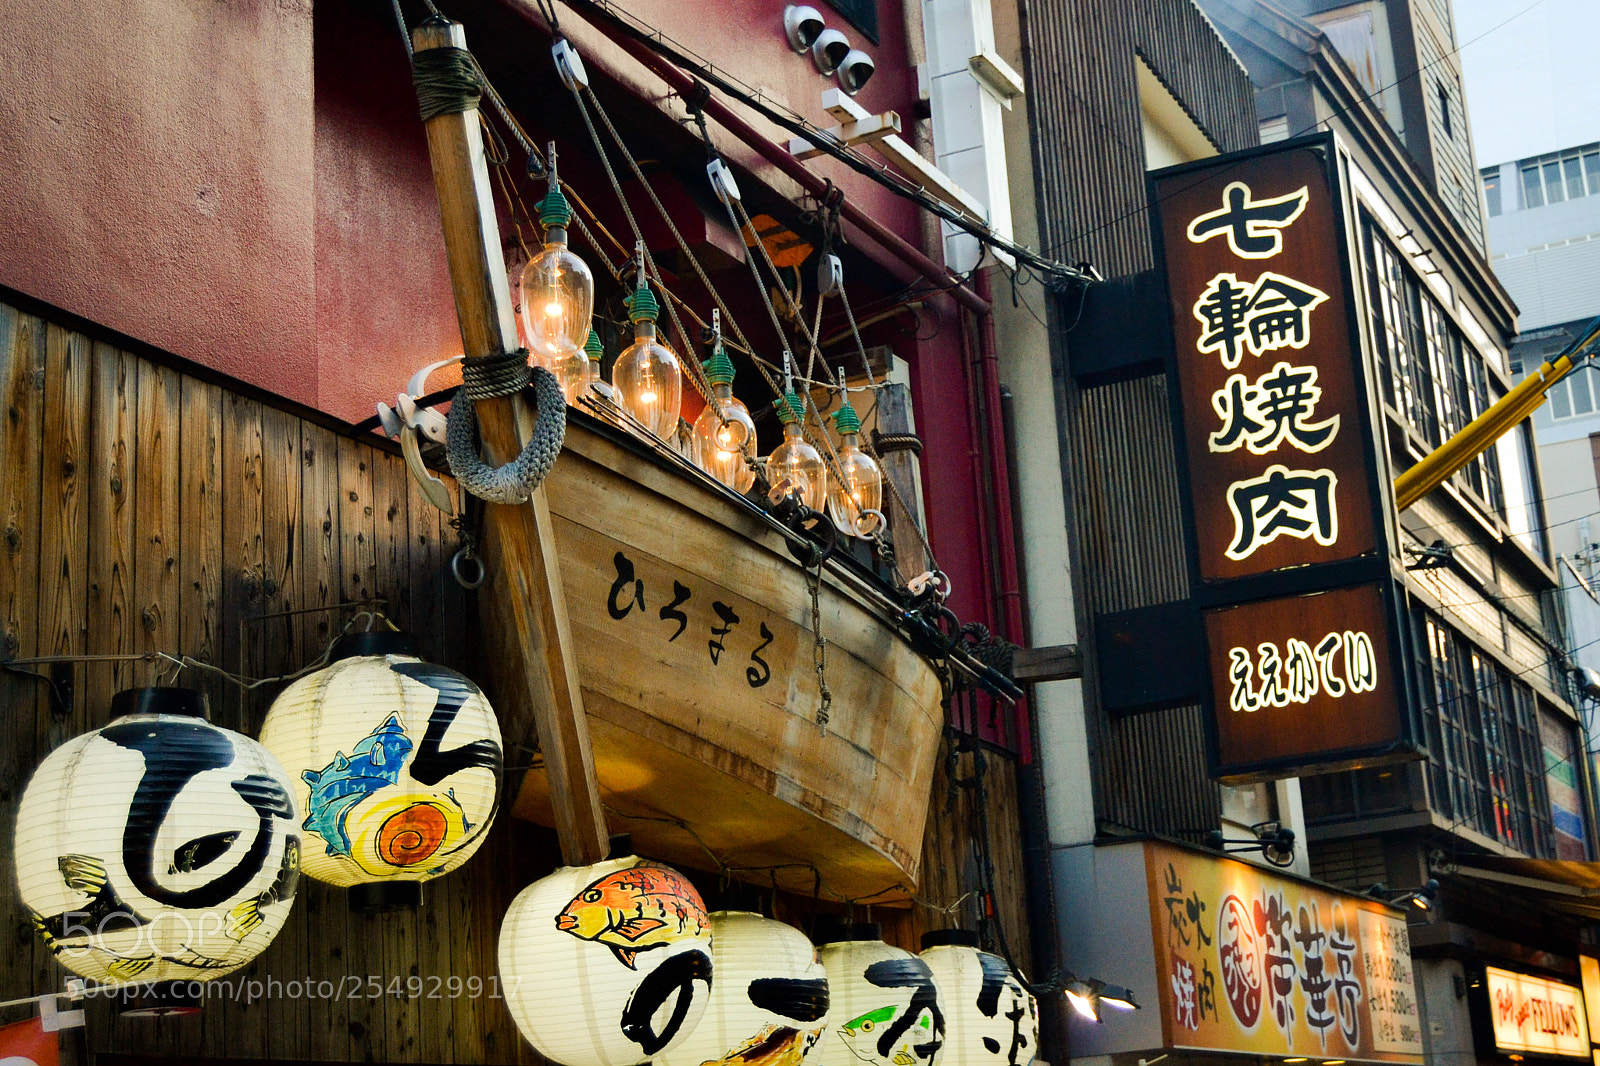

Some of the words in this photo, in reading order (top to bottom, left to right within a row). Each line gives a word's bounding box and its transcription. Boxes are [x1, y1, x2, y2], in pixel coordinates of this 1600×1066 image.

[1186, 181, 1341, 562] 七輪焼肉
[607, 551, 774, 688] ひろまる
[1229, 630, 1378, 712] ええかてい
